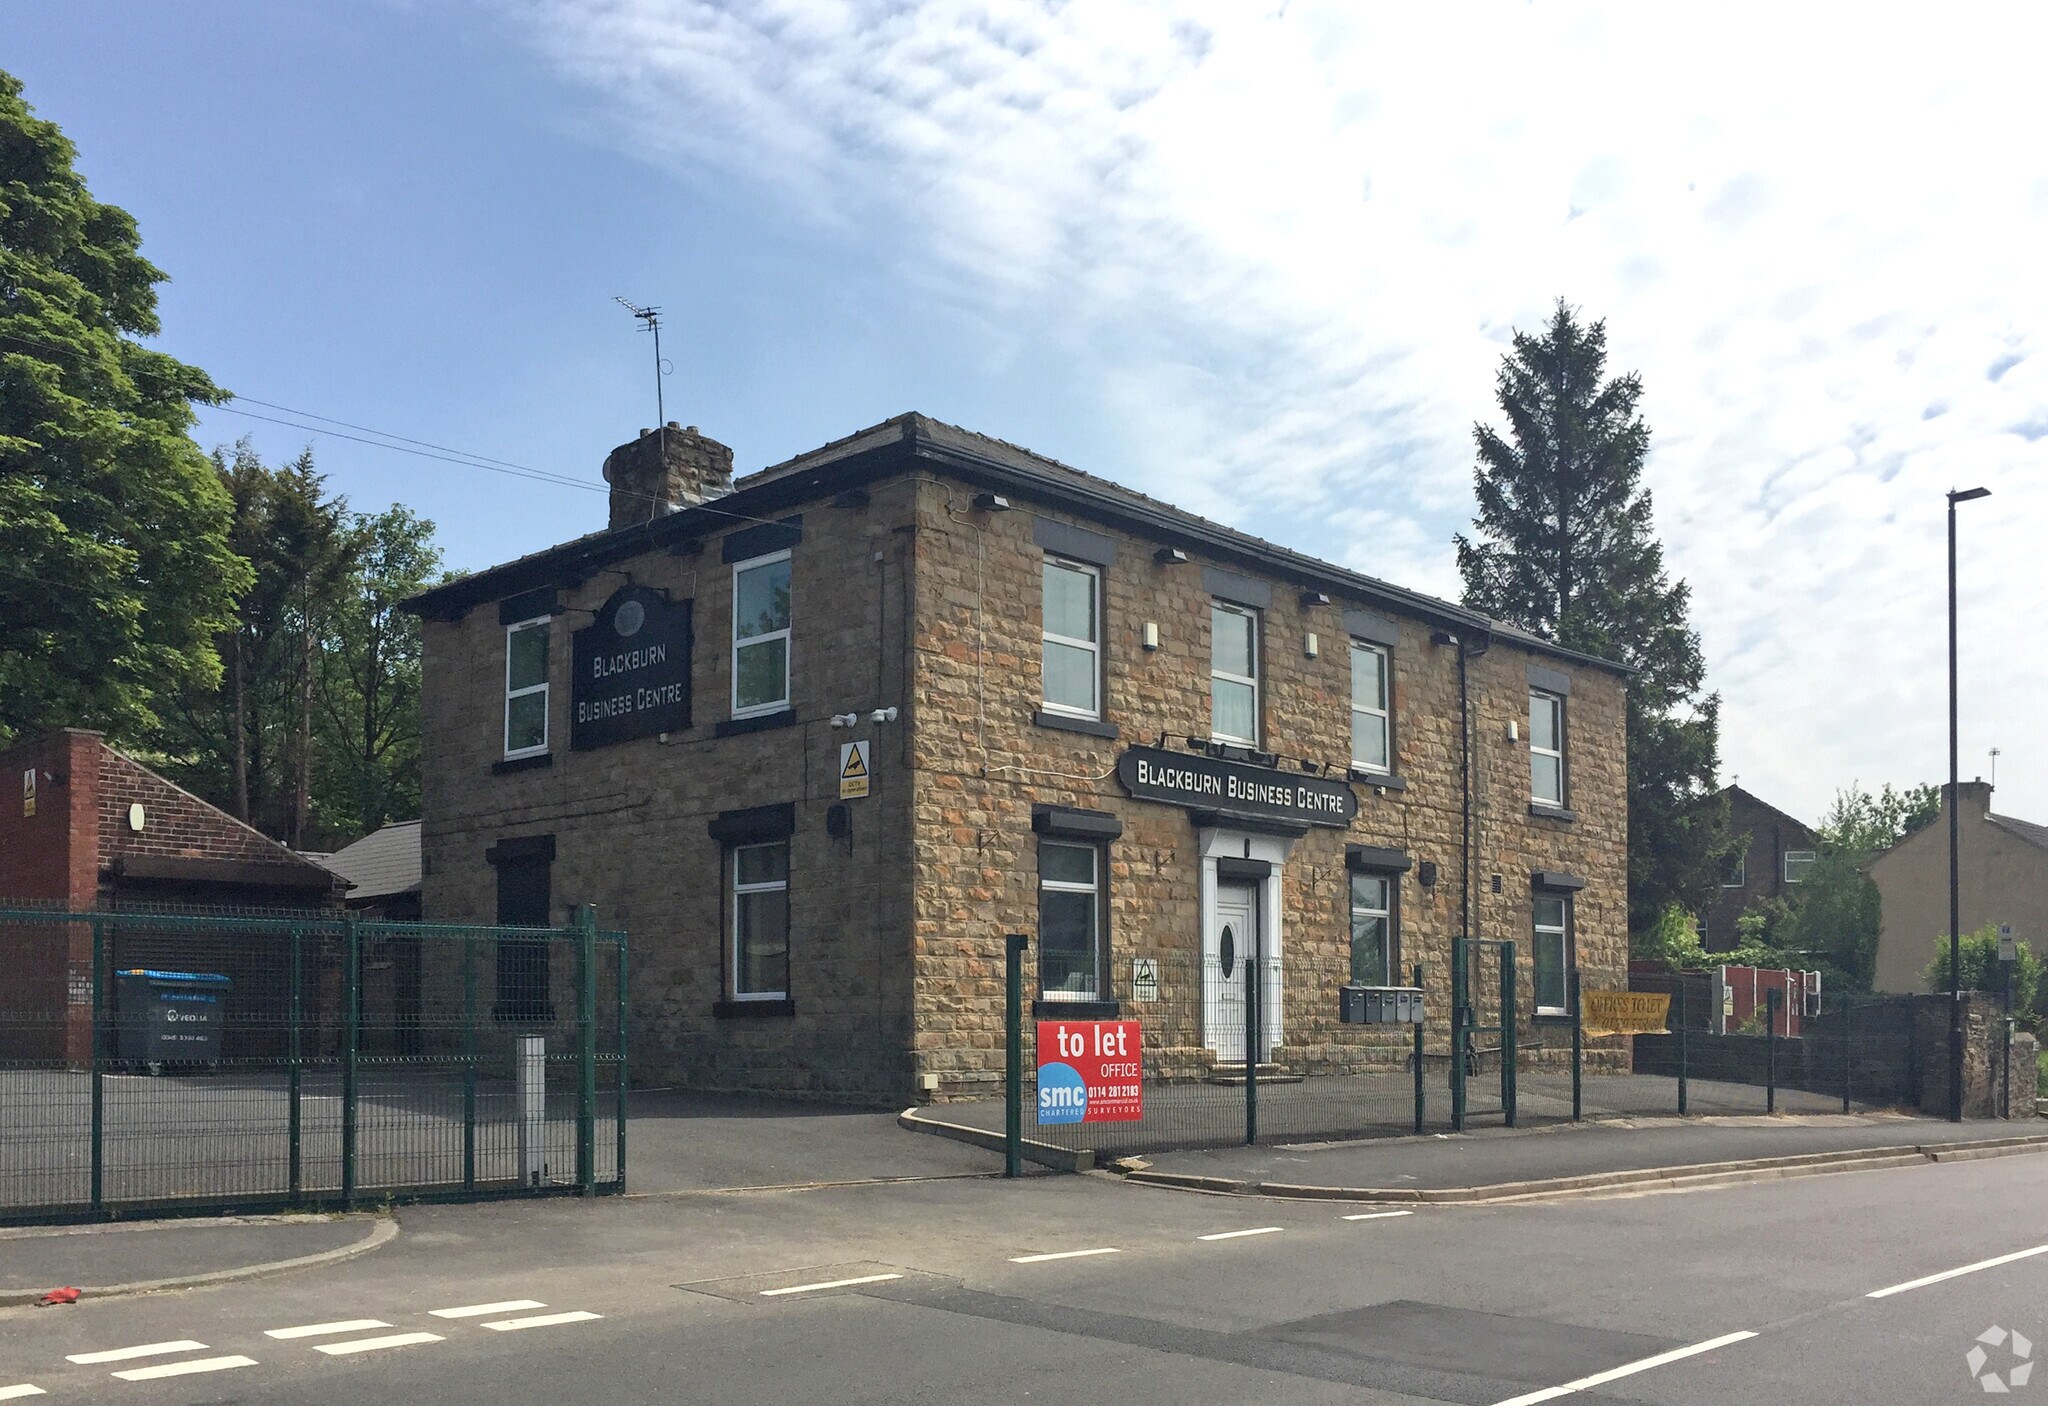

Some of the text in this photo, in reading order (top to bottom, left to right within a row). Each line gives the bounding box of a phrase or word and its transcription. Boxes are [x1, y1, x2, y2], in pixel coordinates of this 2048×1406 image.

[594, 644, 666, 678] BLACKBURN
[579, 683, 682, 723] BUSINESS CENTRE
[1137, 760, 1344, 813] BLACKBURN BUSINESS CENTRE
[1057, 1024, 1127, 1057] to let
[1101, 1063, 1138, 1078] OFFICE
[1040, 1086, 1084, 1108] smc
[1088, 1086, 1106, 1098] 0114
[1040, 1105, 1141, 1117] CHARTERED SURVEYORS
